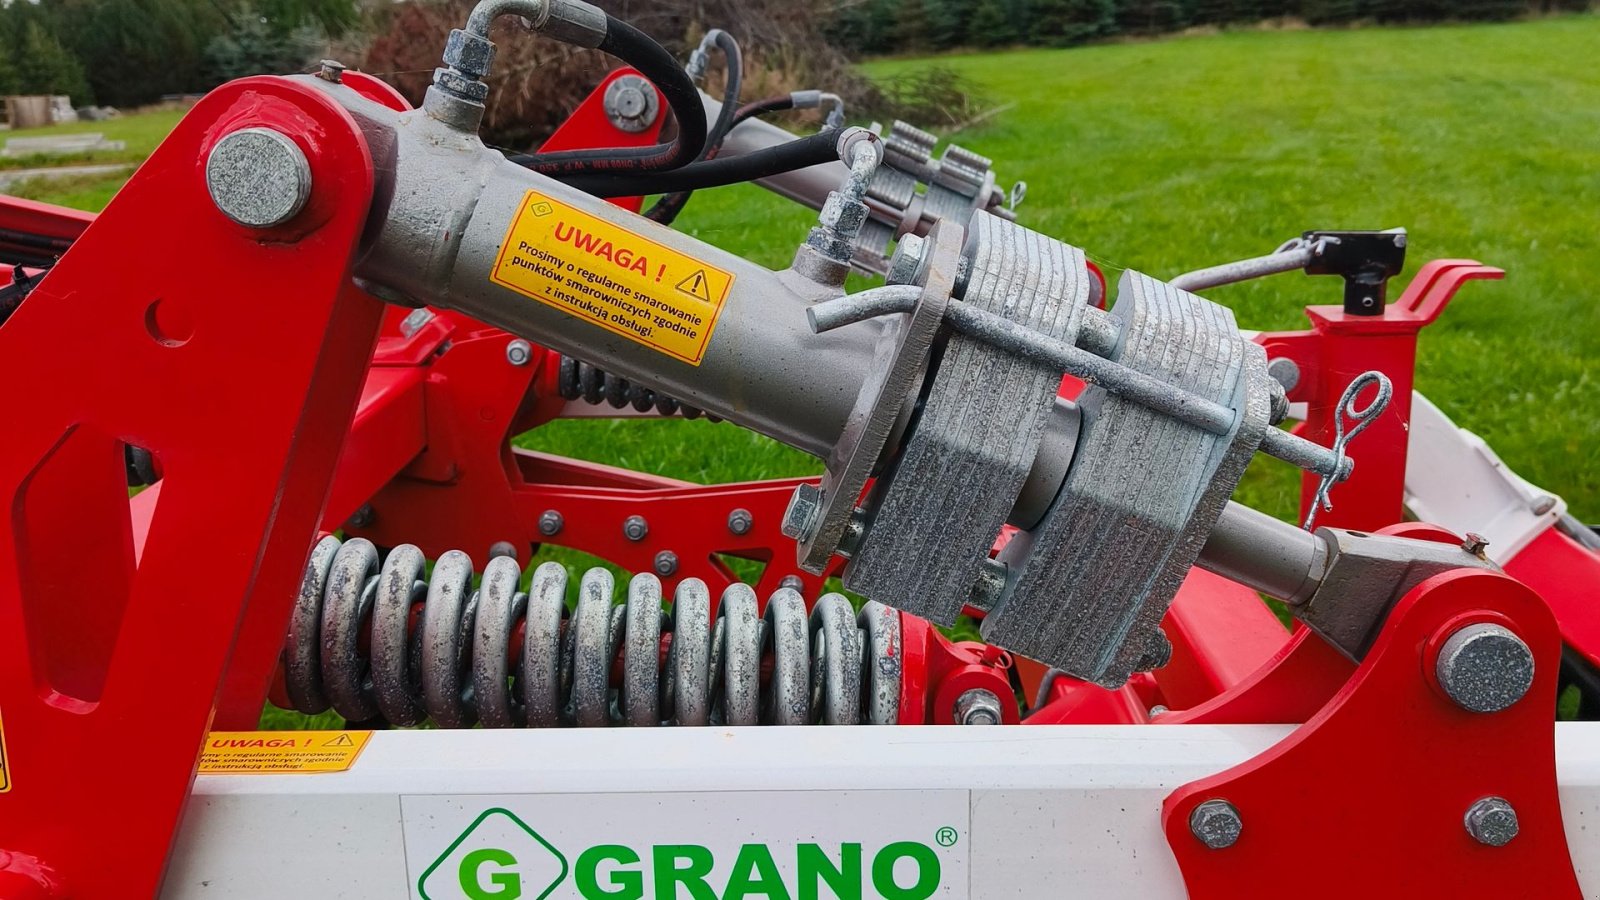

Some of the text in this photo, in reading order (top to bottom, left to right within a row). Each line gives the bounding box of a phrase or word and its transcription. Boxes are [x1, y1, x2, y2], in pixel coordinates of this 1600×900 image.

[554, 221, 667, 283] UWAGA !
[512, 255, 697, 339] punktów smarowniczych zgodnie
[518, 241, 702, 326] Prosimy o regularne smarowanie
[545, 286, 654, 338] z instrukcją obsługi.
[212, 738, 313, 748] UWAGA !
[459, 841, 942, 900] G GRANO
